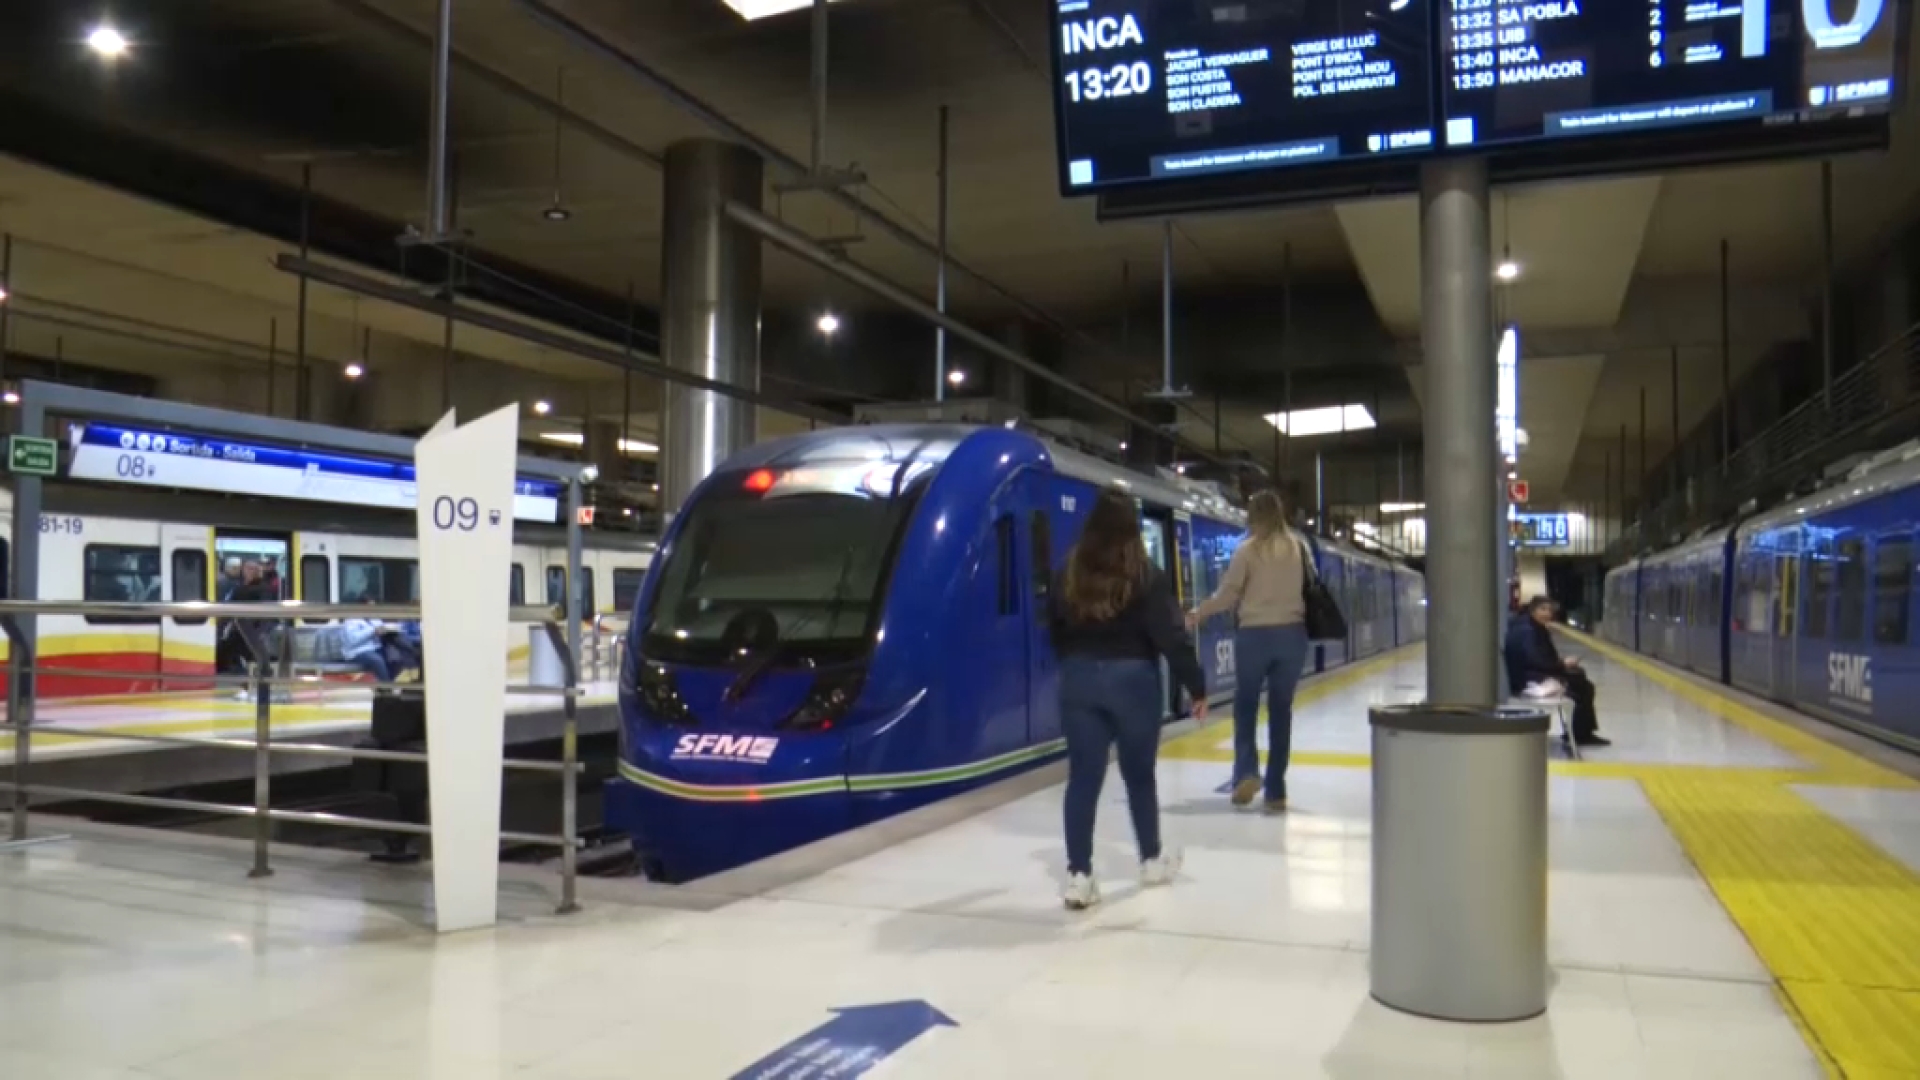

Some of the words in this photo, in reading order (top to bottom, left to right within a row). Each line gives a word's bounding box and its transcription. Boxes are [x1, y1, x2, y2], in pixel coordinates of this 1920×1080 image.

[1451, 11, 1493, 31] 13:32
[1498, 7, 1521, 25] SA
[1522, 0, 1579, 21] POBLA
[1649, 9, 1661, 27] 2
[1062, 13, 1144, 54] INCA
[1330, 37, 1345, 51] DE
[1346, 33, 1377, 49] LLUC
[1451, 31, 1493, 50] 13:35
[1498, 26, 1527, 45] UIB
[1649, 29, 1661, 47] 9
[1292, 55, 1323, 70] PONT
[1452, 50, 1494, 70] 13:40
[1499, 45, 1540, 65] INCA
[1649, 50, 1661, 67] 6
[1064, 60, 1151, 102] 13:20
[1292, 69, 1323, 84] PONT
[1364, 59, 1391, 75] NOU
[1452, 70, 1494, 90] 13:50
[1499, 60, 1584, 85] MANACOR
[1320, 80, 1336, 95] DE
[117, 454, 145, 478] 08
[434, 495, 479, 531] 09
[673, 733, 757, 757] SFM
